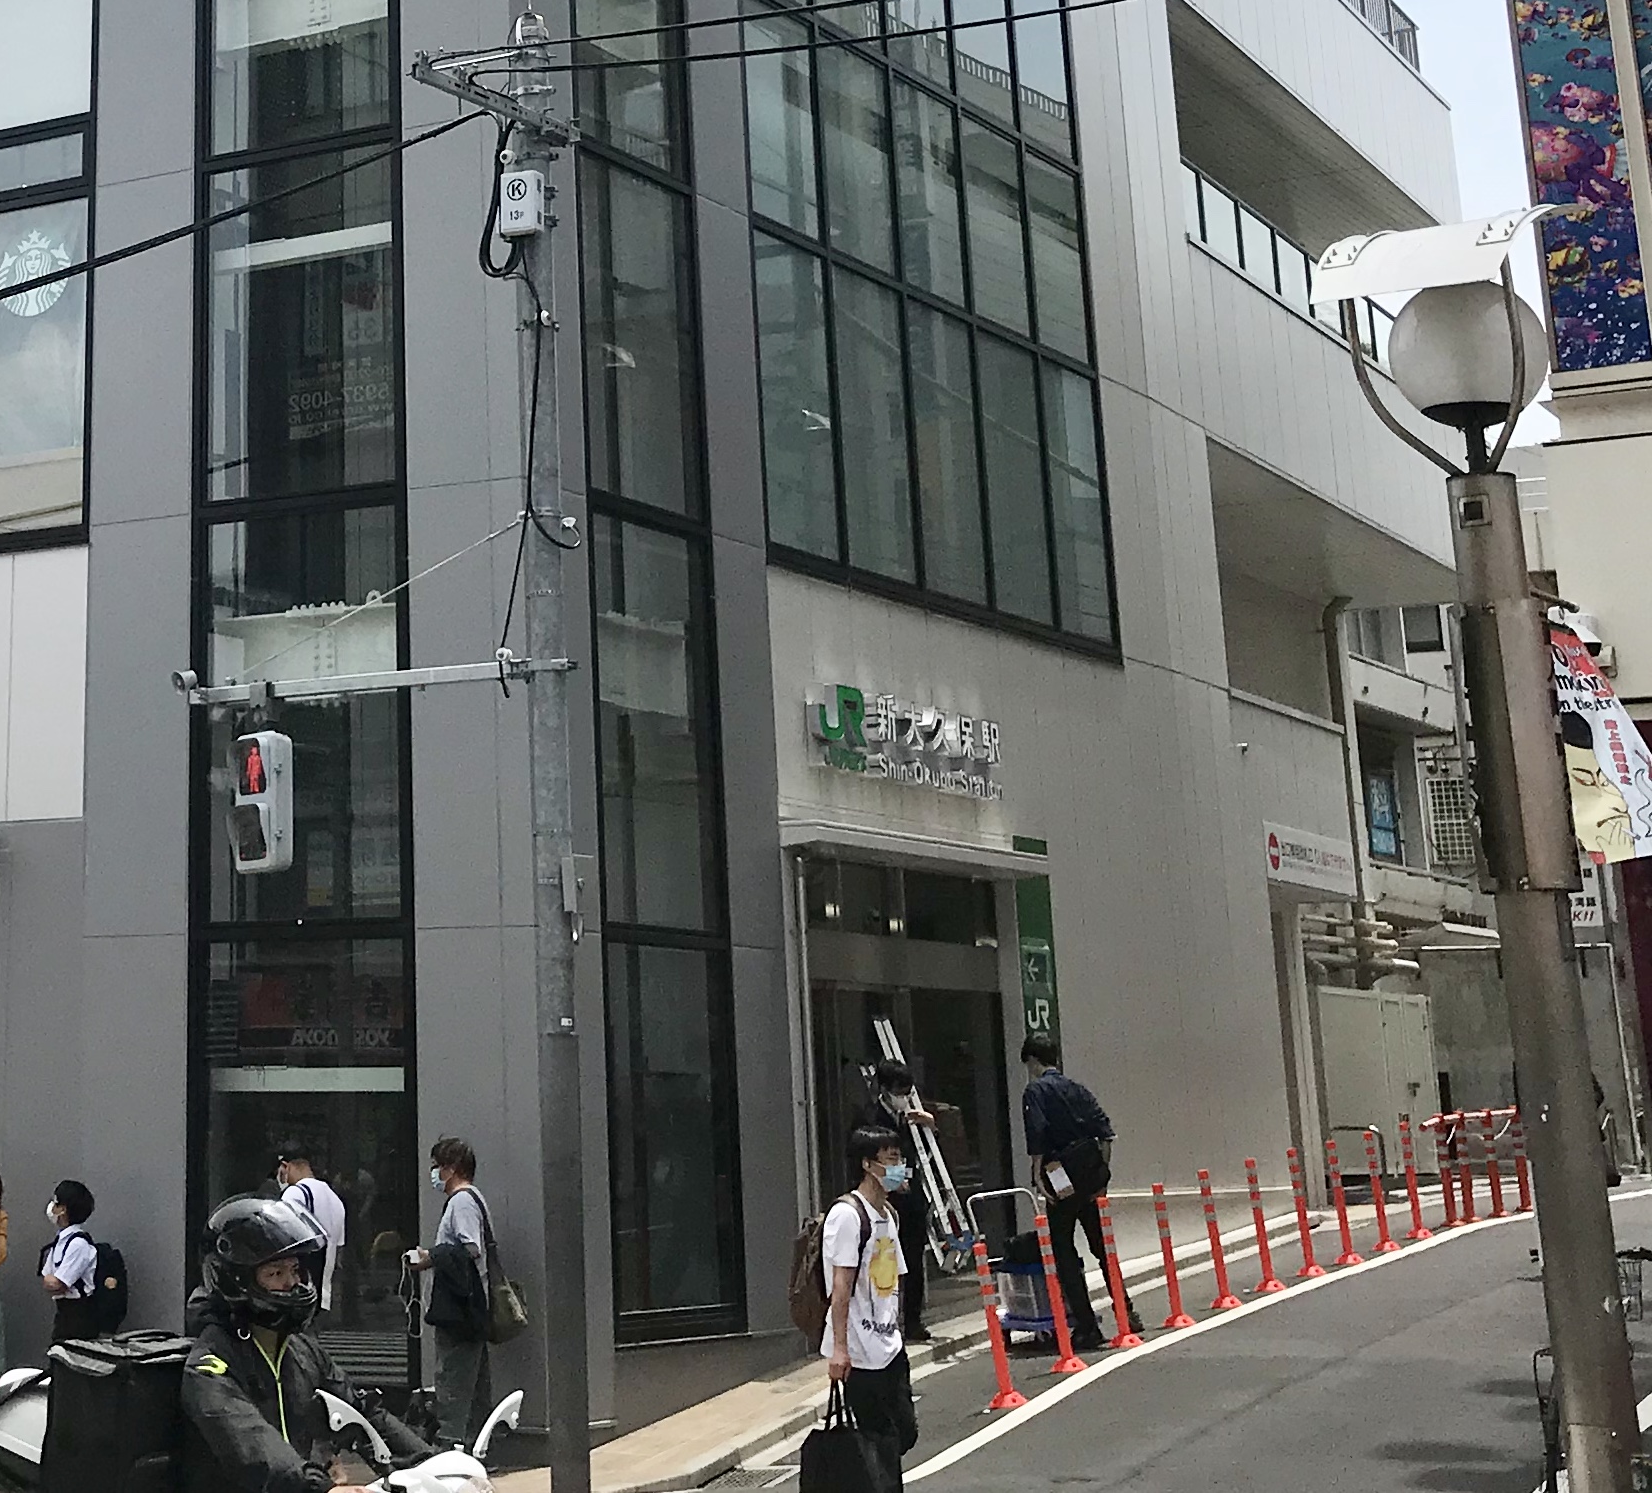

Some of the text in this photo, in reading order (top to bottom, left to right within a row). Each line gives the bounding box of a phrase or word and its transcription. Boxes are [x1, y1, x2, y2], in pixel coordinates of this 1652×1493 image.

[819, 684, 867, 747] JR
[876, 693, 1001, 764] 新大久保駅
[877, 752, 956, 790] Shin-Okubo
[959, 770, 1004, 800] Station
[1028, 998, 1050, 1030] JR
